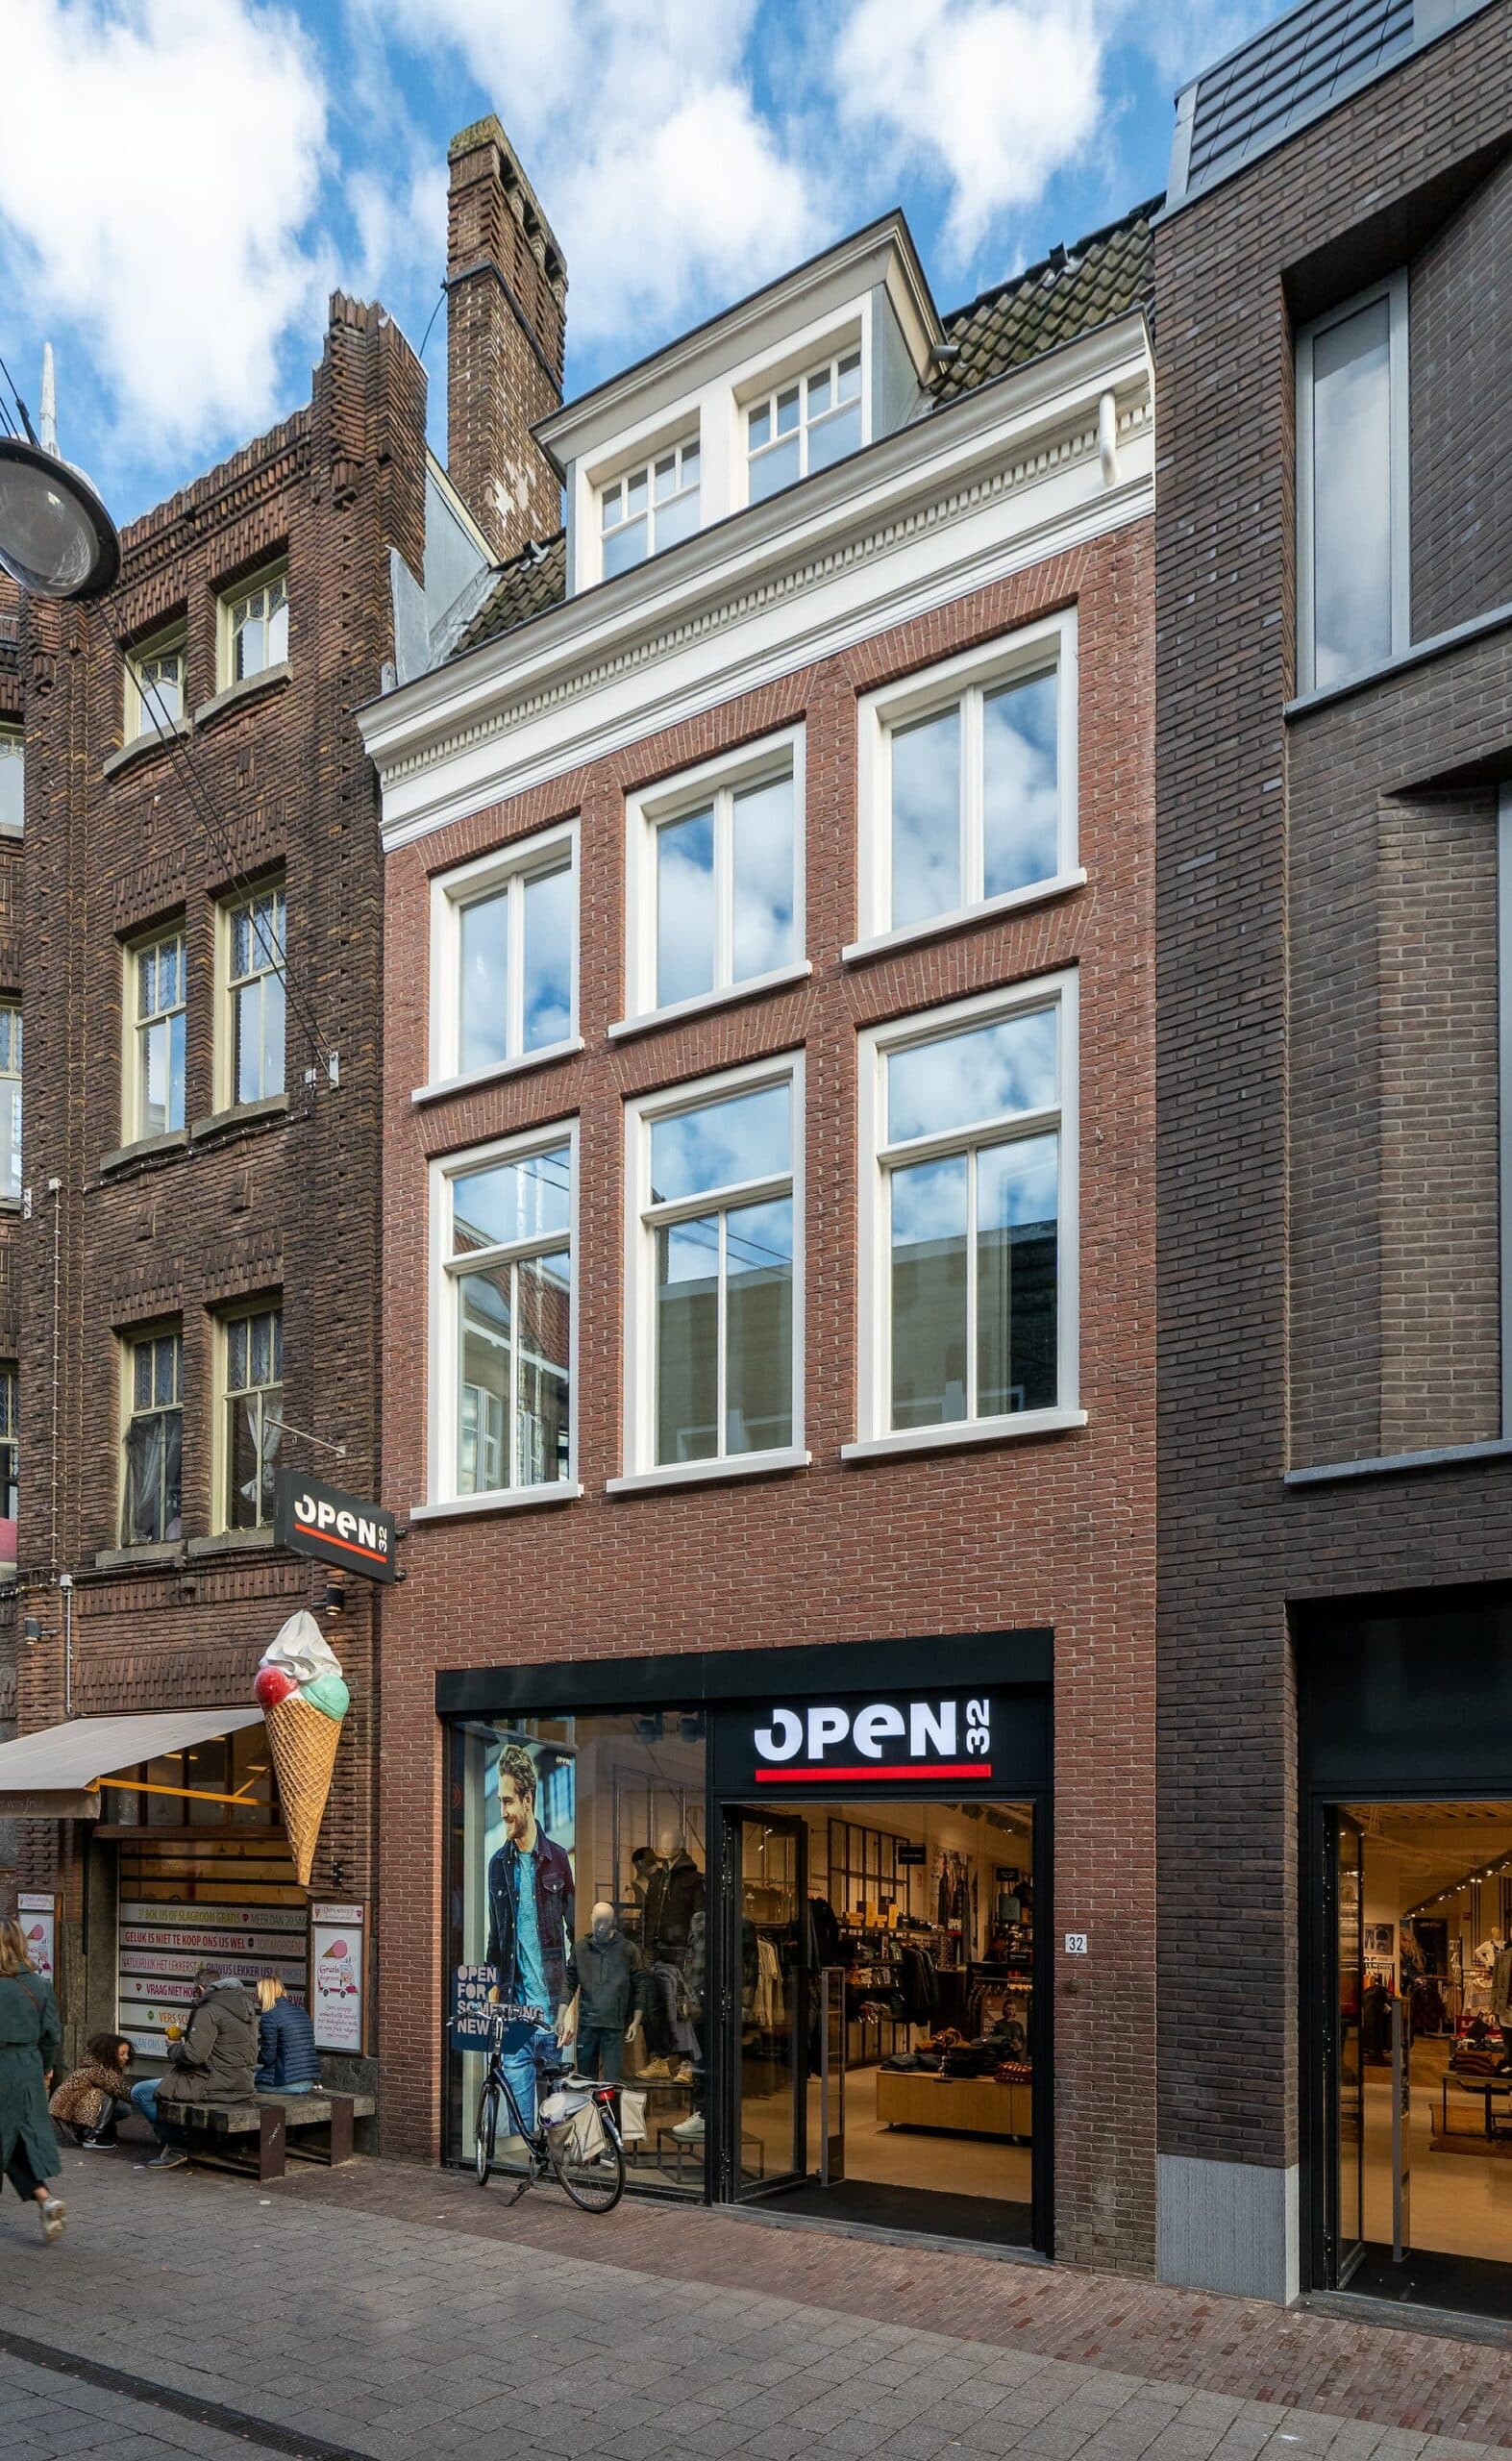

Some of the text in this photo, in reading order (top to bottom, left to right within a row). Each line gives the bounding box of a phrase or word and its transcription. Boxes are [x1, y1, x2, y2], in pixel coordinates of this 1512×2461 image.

[378, 1526, 387, 1554] 32
[966, 1699, 990, 1754] 32
[179, 1910, 215, 1924] SLAGROOM
[216, 1912, 241, 1924] GRATIS
[125, 1930, 147, 1943] GELUK
[148, 1932, 155, 1944] IS
[156, 1932, 171, 1945] NIET
[172, 1933, 181, 1945] TE
[182, 1934, 202, 1946] KOOP
[202, 1935, 217, 1948] ONS
[231, 1937, 246, 1950] WEL
[1069, 1936, 1083, 1951] 32
[156, 1959, 167, 1970] HET
[233, 1964, 260, 1977] LEKKER
[457, 1964, 497, 1982] OPEN
[146, 1983, 167, 1996] VRAAG
[167, 1984, 183, 1997] NIET
[457, 1982, 486, 2000] FOR
[457, 2018, 491, 2035] NEW
